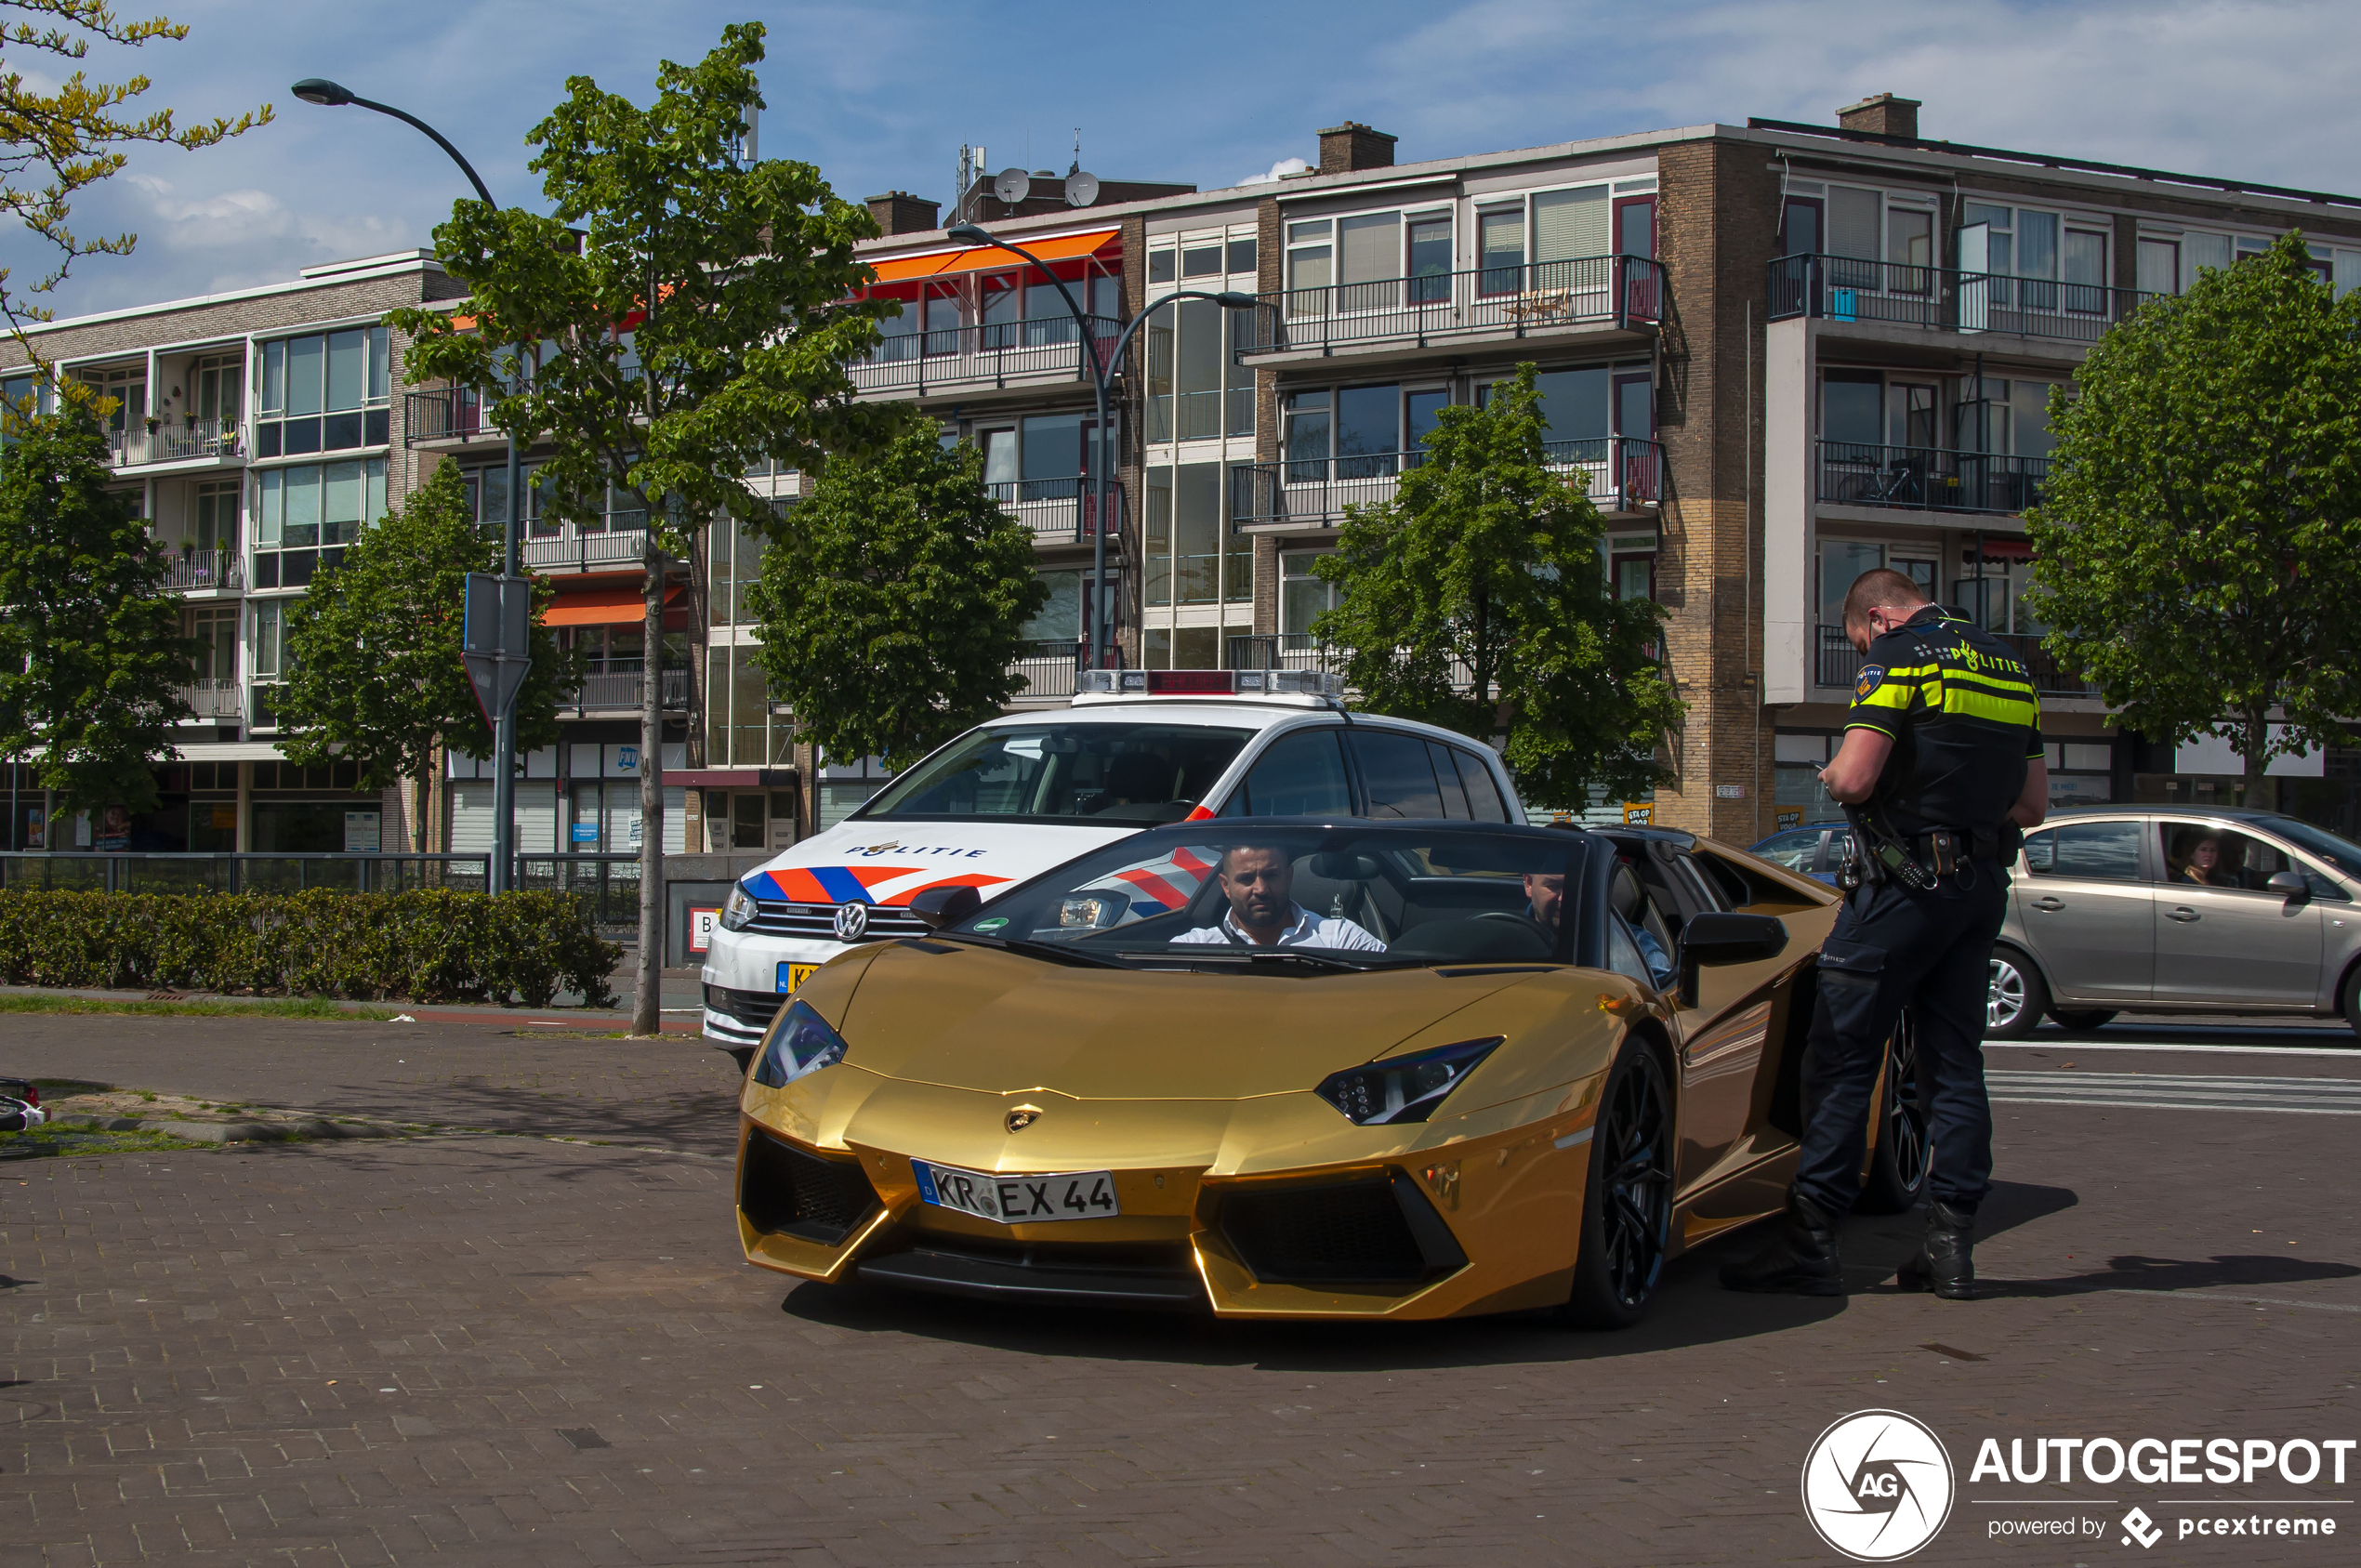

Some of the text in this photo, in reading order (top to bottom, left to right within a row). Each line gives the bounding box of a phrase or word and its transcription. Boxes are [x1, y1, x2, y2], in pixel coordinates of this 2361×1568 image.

[1949, 644, 2022, 674] POLITIE
[618, 749, 638, 765] FNV
[1628, 809, 1650, 820] STA OP
[1777, 812, 1800, 824] STA OP
[845, 845, 988, 858] POLITIE
[924, 1185, 932, 1196] D
[931, 1169, 1113, 1217] KR EX 44
